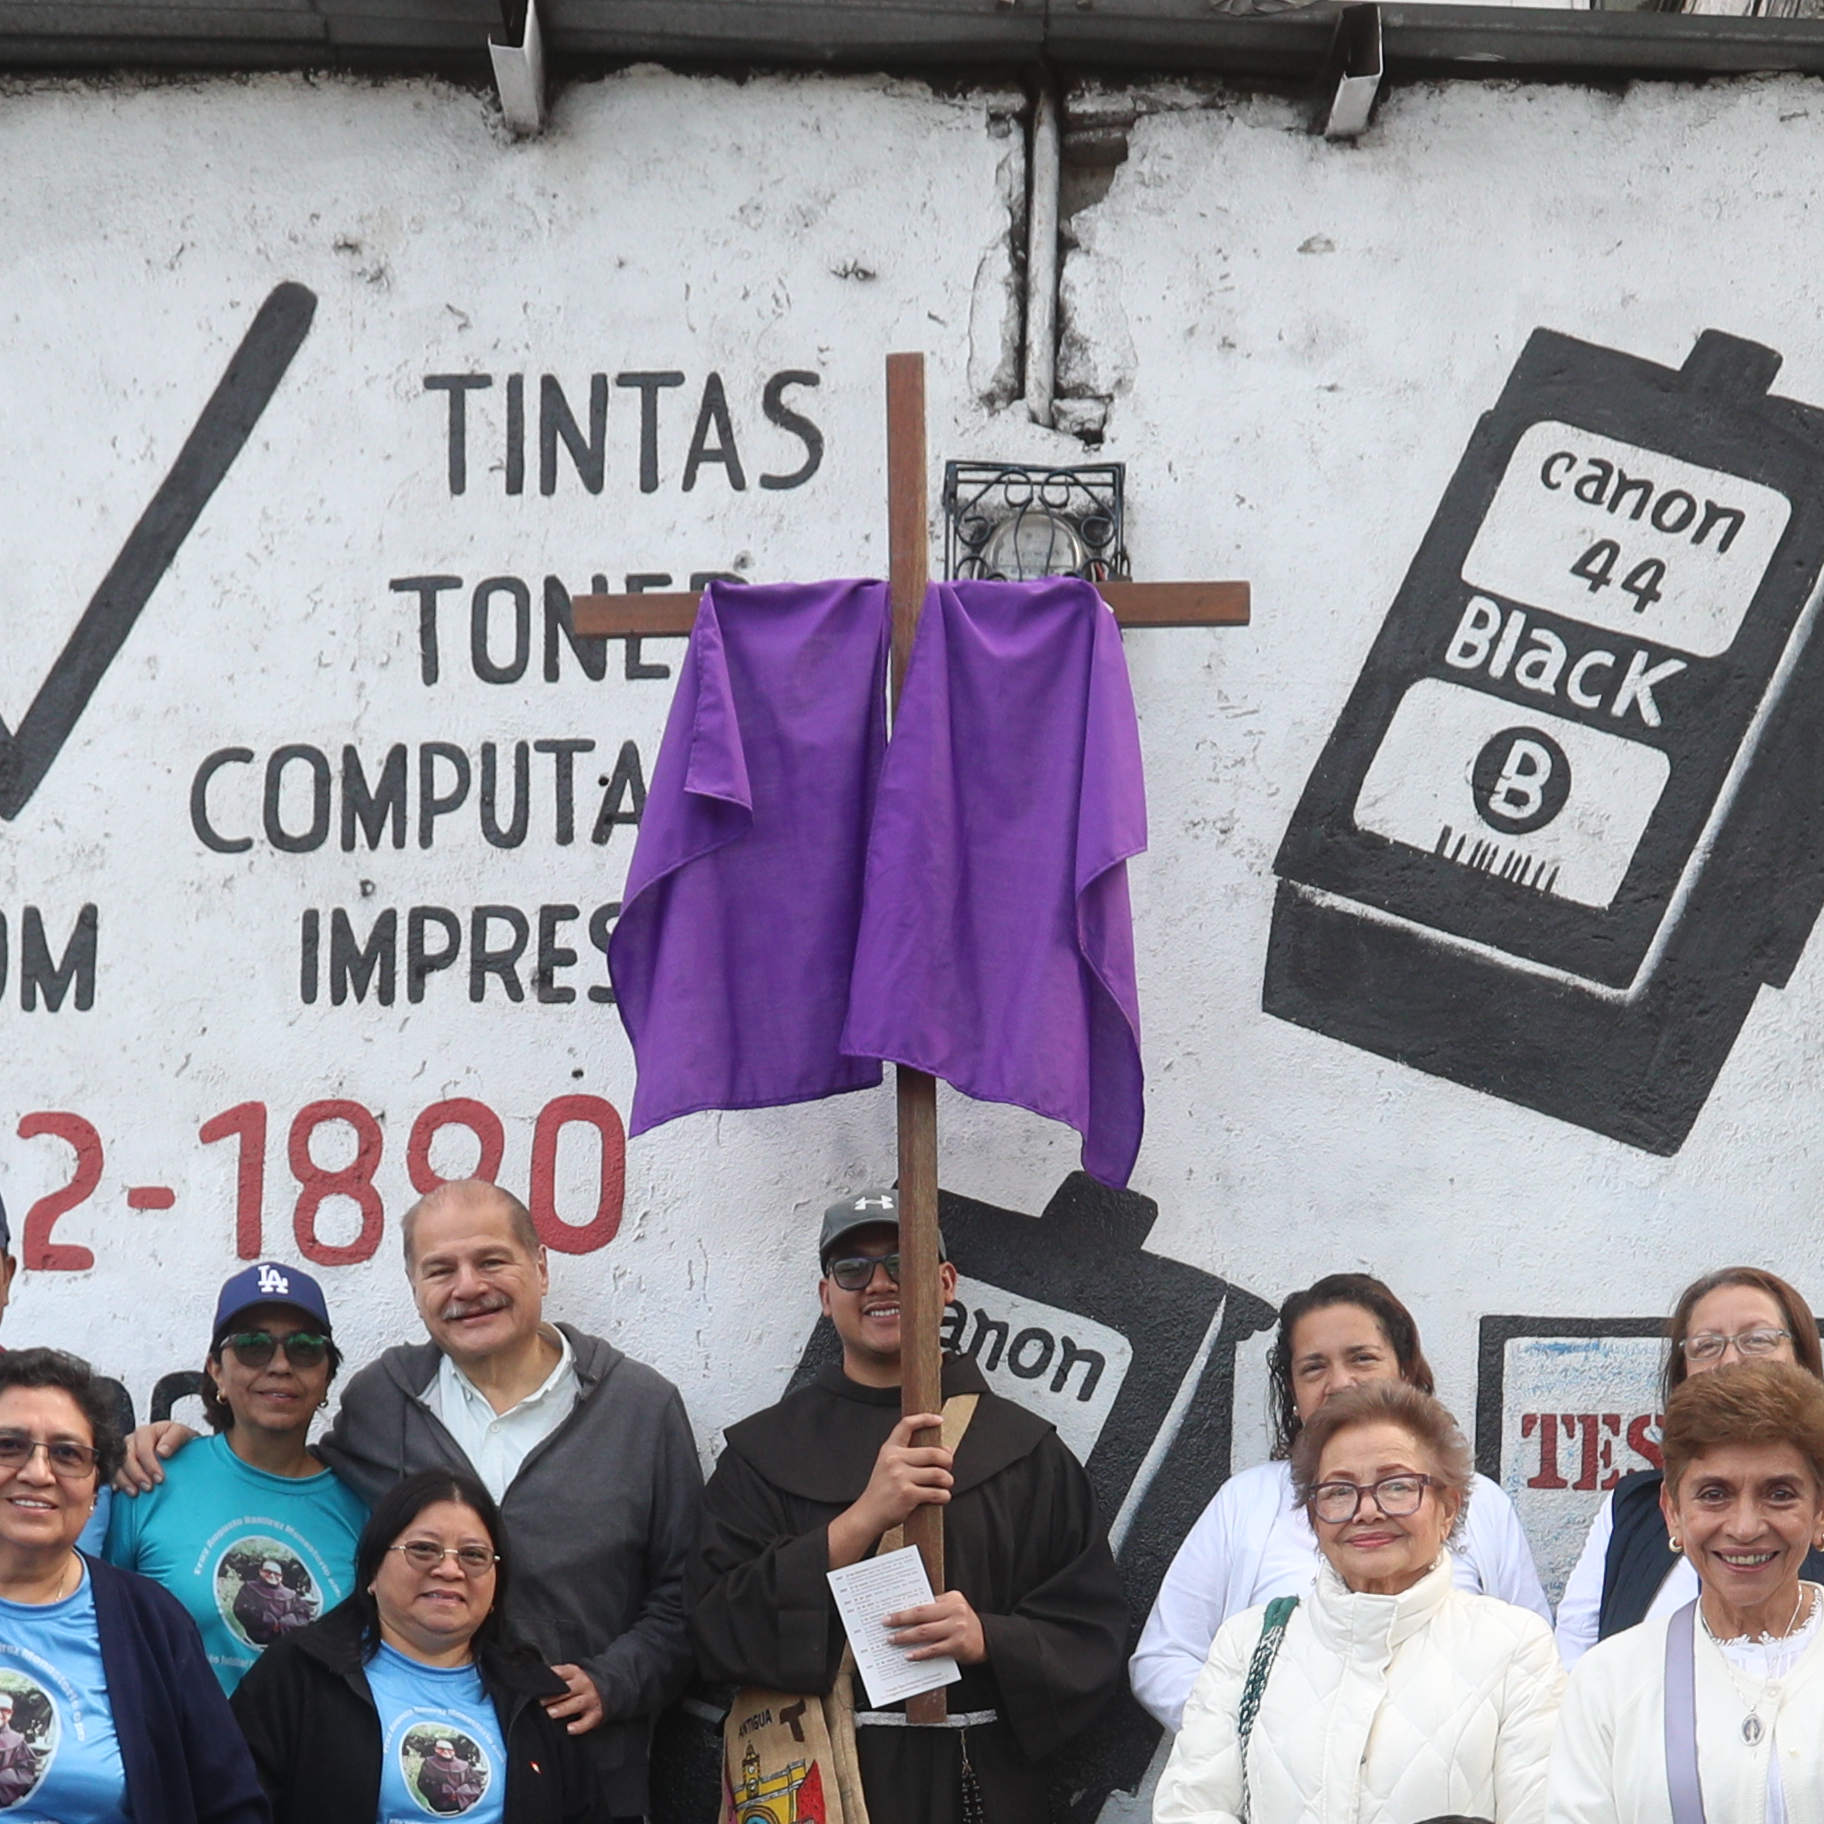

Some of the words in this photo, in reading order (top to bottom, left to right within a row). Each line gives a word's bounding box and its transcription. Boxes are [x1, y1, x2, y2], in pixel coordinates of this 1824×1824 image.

[423, 369, 825, 496] TINTAS
[1539, 450, 1747, 554] canon
[1569, 538, 1668, 614] 44
[388, 572, 750, 687] TONE
[188, 739, 649, 854] COMPUTA
[1487, 737, 1554, 821] B
[257, 1264, 289, 1294] LA
[940, 1299, 1106, 1403] anon
[1521, 1413, 1666, 1491] TES
[737, 1709, 773, 1740] ANTIGUA
